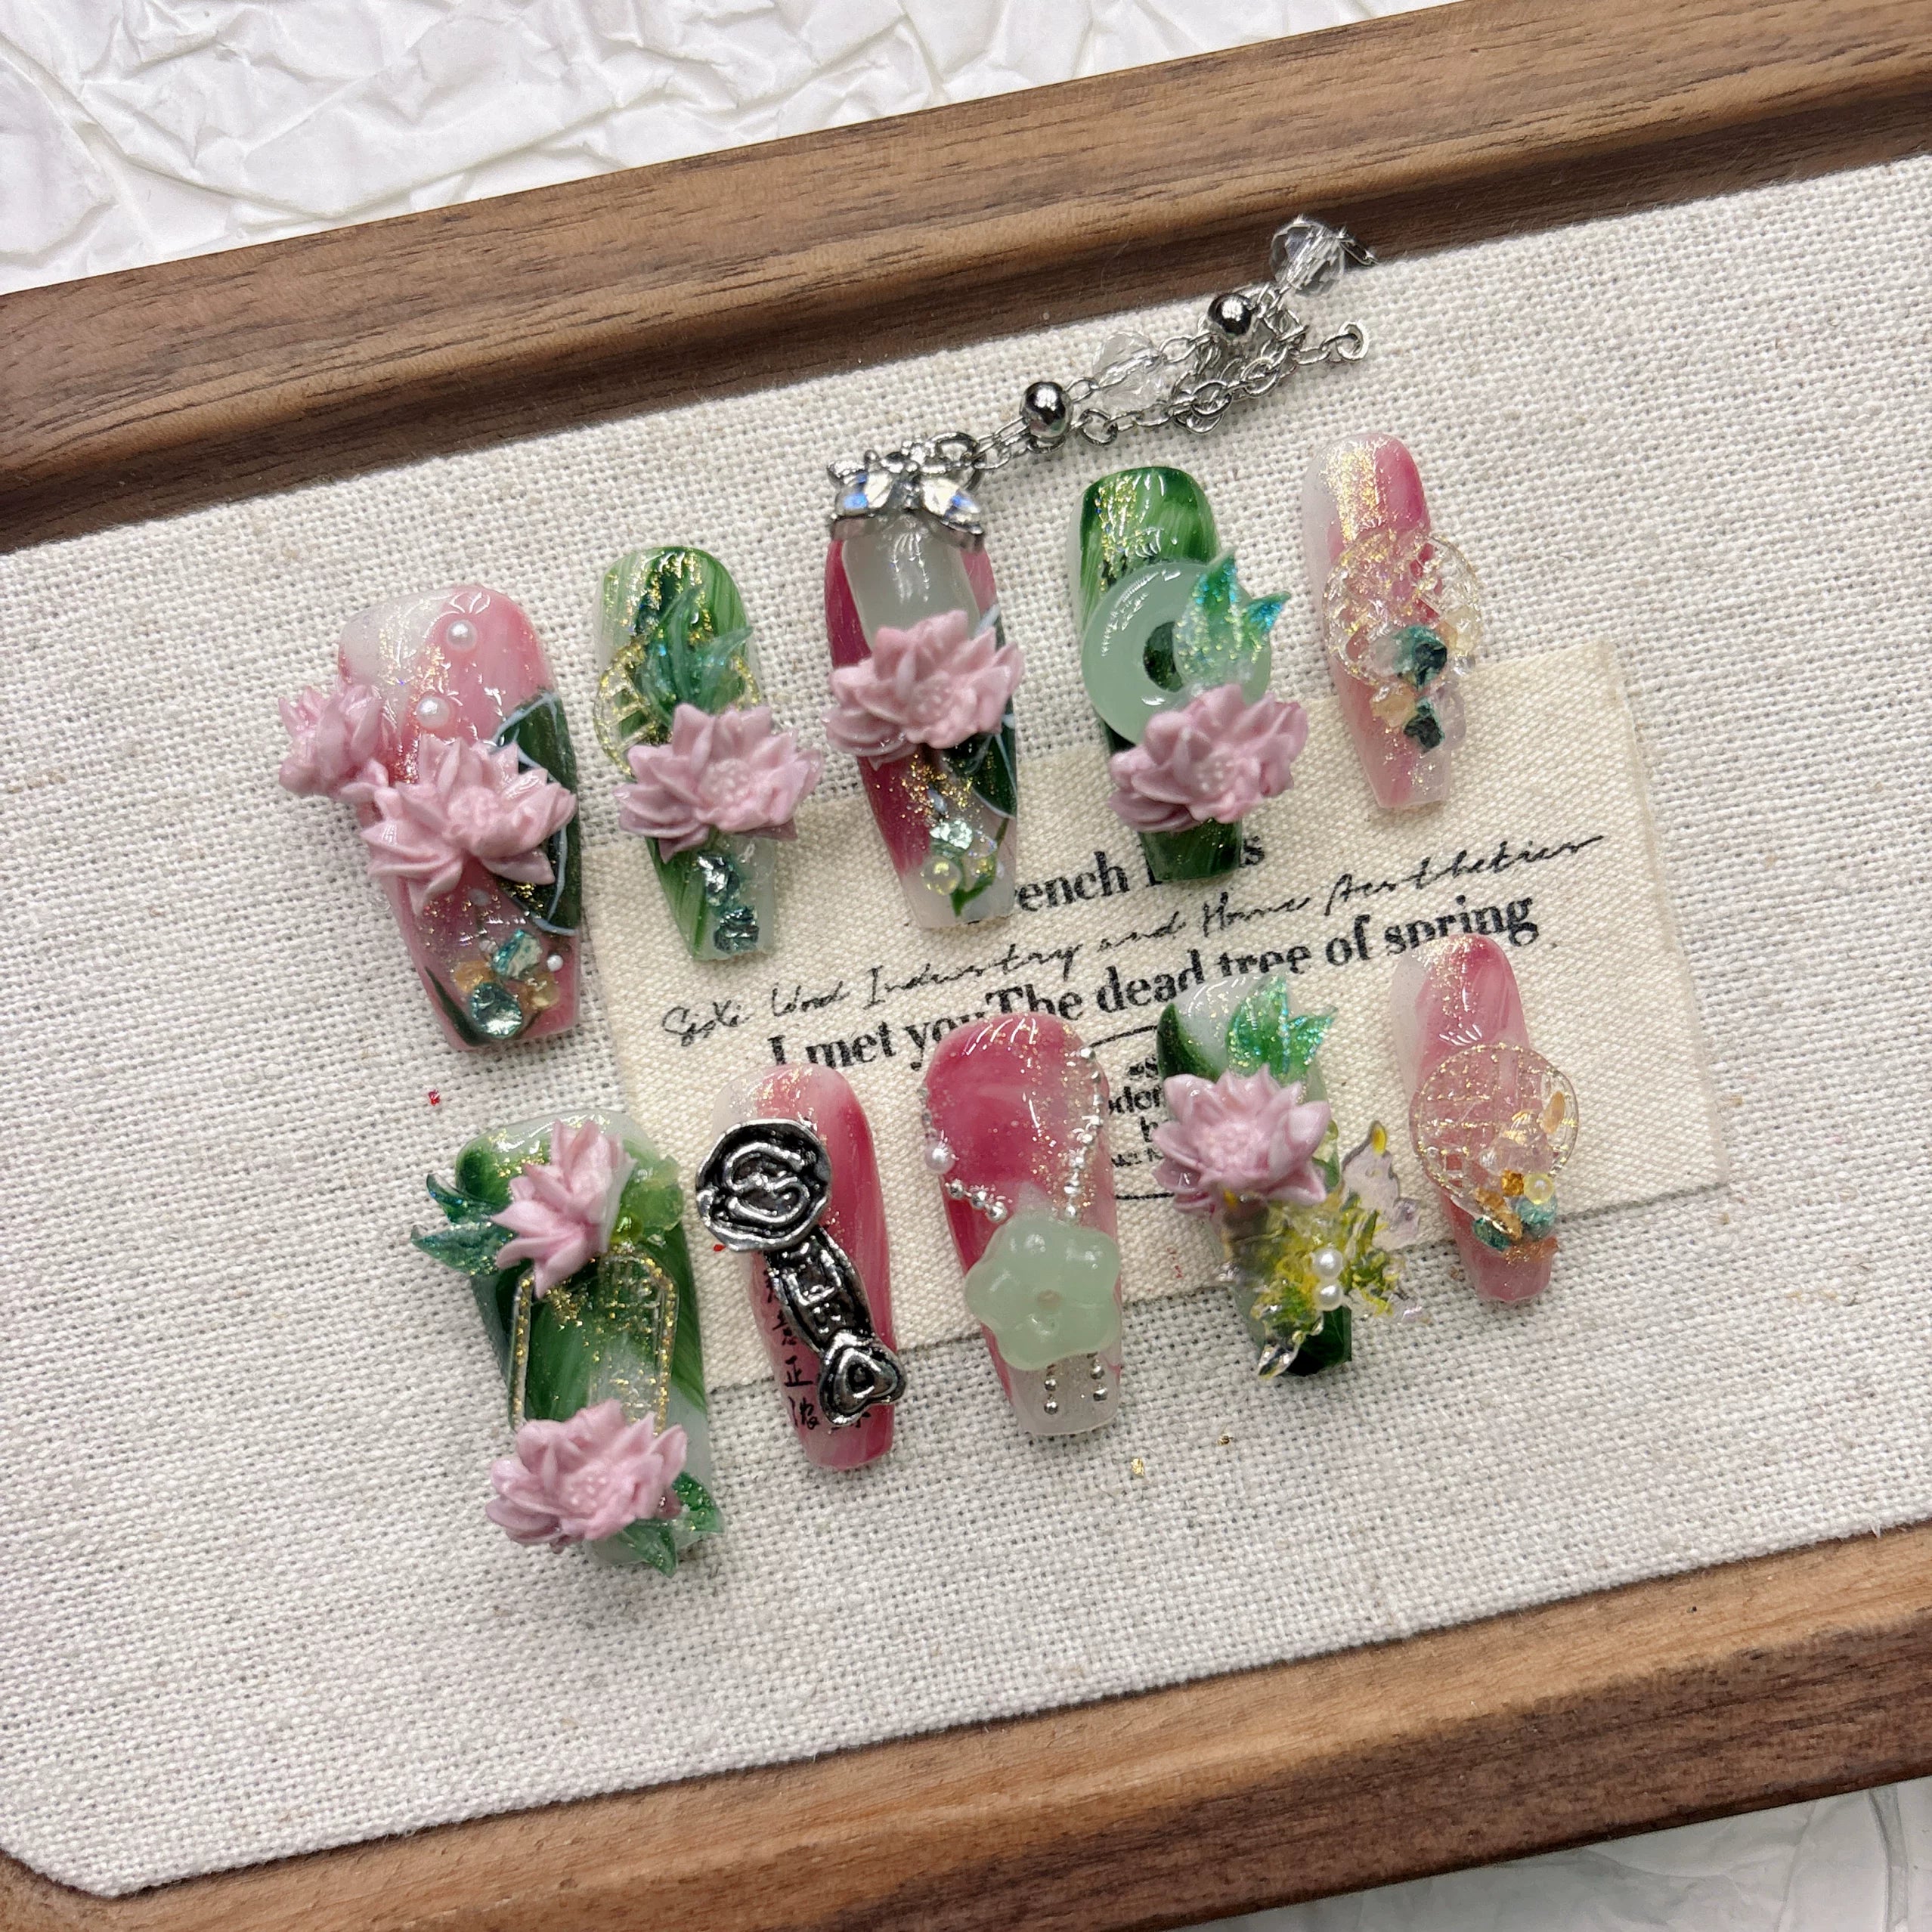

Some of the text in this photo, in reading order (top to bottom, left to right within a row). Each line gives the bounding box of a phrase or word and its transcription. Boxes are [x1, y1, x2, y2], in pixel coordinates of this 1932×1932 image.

[1014, 851, 1130, 912] ench
[1097, 911, 1187, 953] and
[767, 1034, 787, 1065] I
[804, 1021, 897, 1070] met
[1096, 948, 1206, 1014] dead
[1325, 913, 1371, 967] of
[1383, 893, 1540, 957] spring
